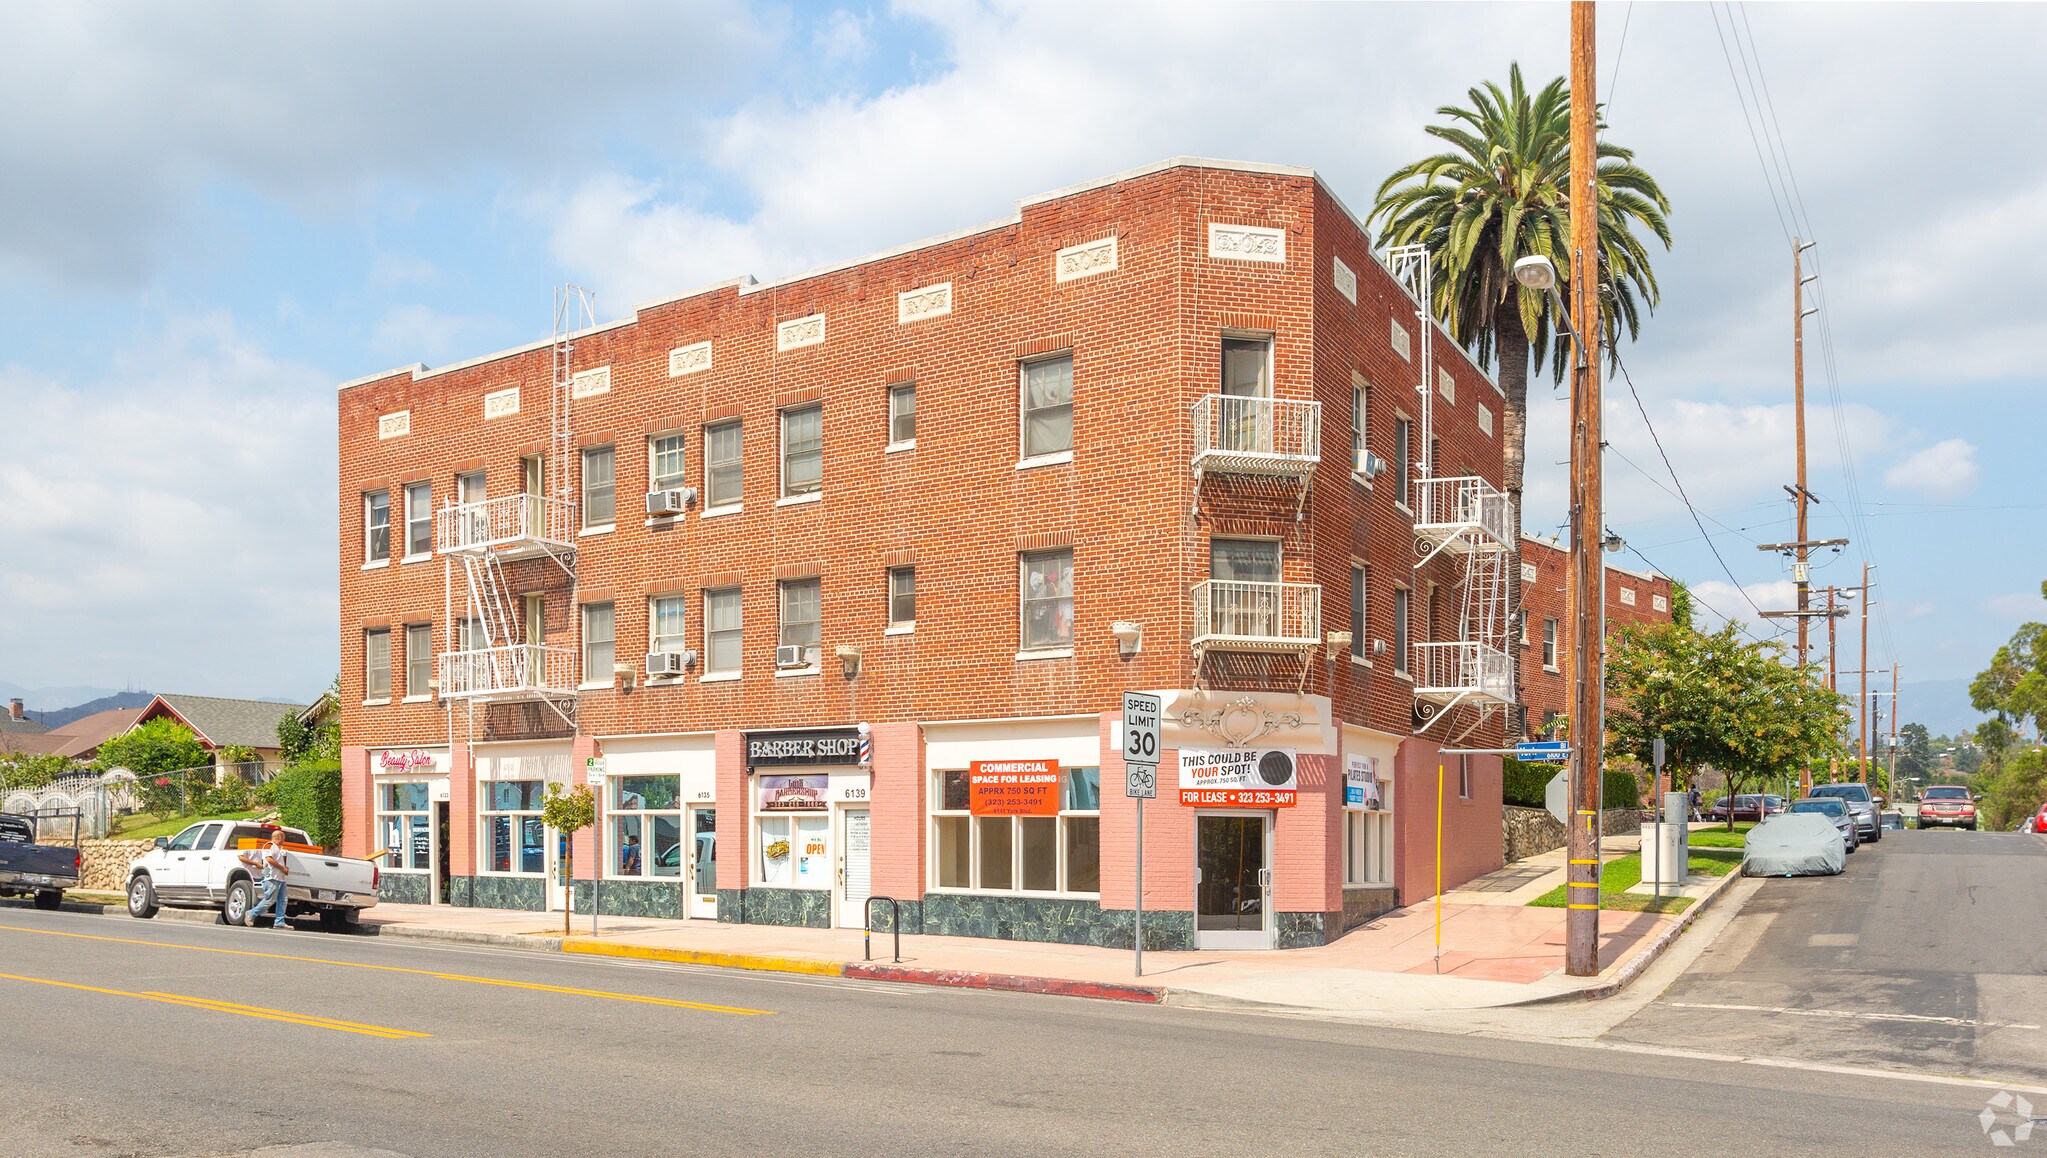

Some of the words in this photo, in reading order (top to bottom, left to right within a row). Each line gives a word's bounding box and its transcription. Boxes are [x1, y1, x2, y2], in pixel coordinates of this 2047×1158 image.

[1128, 699, 1157, 713] SPEED
[1129, 714, 1156, 728] LIMIT
[750, 740, 816, 758] BARBER
[817, 738, 860, 756] SHOP
[1128, 730, 1156, 756] 30
[380, 750, 407, 772] Beauty
[407, 749, 431, 768] Salon
[1183, 756, 1206, 767] THIS
[1208, 752, 1241, 765] COULD
[1243, 751, 1257, 762] BE
[980, 762, 1048, 773] COMMERCIAL
[1191, 767, 1219, 779] YOUR
[1221, 764, 1251, 776] SPOT!
[972, 775, 999, 784] SPACE
[1001, 775, 1018, 783] FOR
[1020, 774, 1057, 783] LEASING
[1348, 769, 1360, 782] PILATES
[845, 789, 866, 798] 6139
[978, 787, 1005, 795] APPRX
[1007, 787, 1021, 795] 750
[1023, 787, 1035, 795] SQ
[1037, 786, 1048, 794] FT
[1130, 788, 1140, 796] BIKE
[1141, 789, 1153, 797] LANE
[984, 798, 1005, 807] (323)
[1007, 798, 1042, 806] 253-3491
[1182, 792, 1199, 803] FOR
[1201, 792, 1227, 803] LEASE
[1238, 792, 1253, 803] 323
[1255, 792, 1294, 804] 253-3491
[806, 844, 825, 854] OPEN
